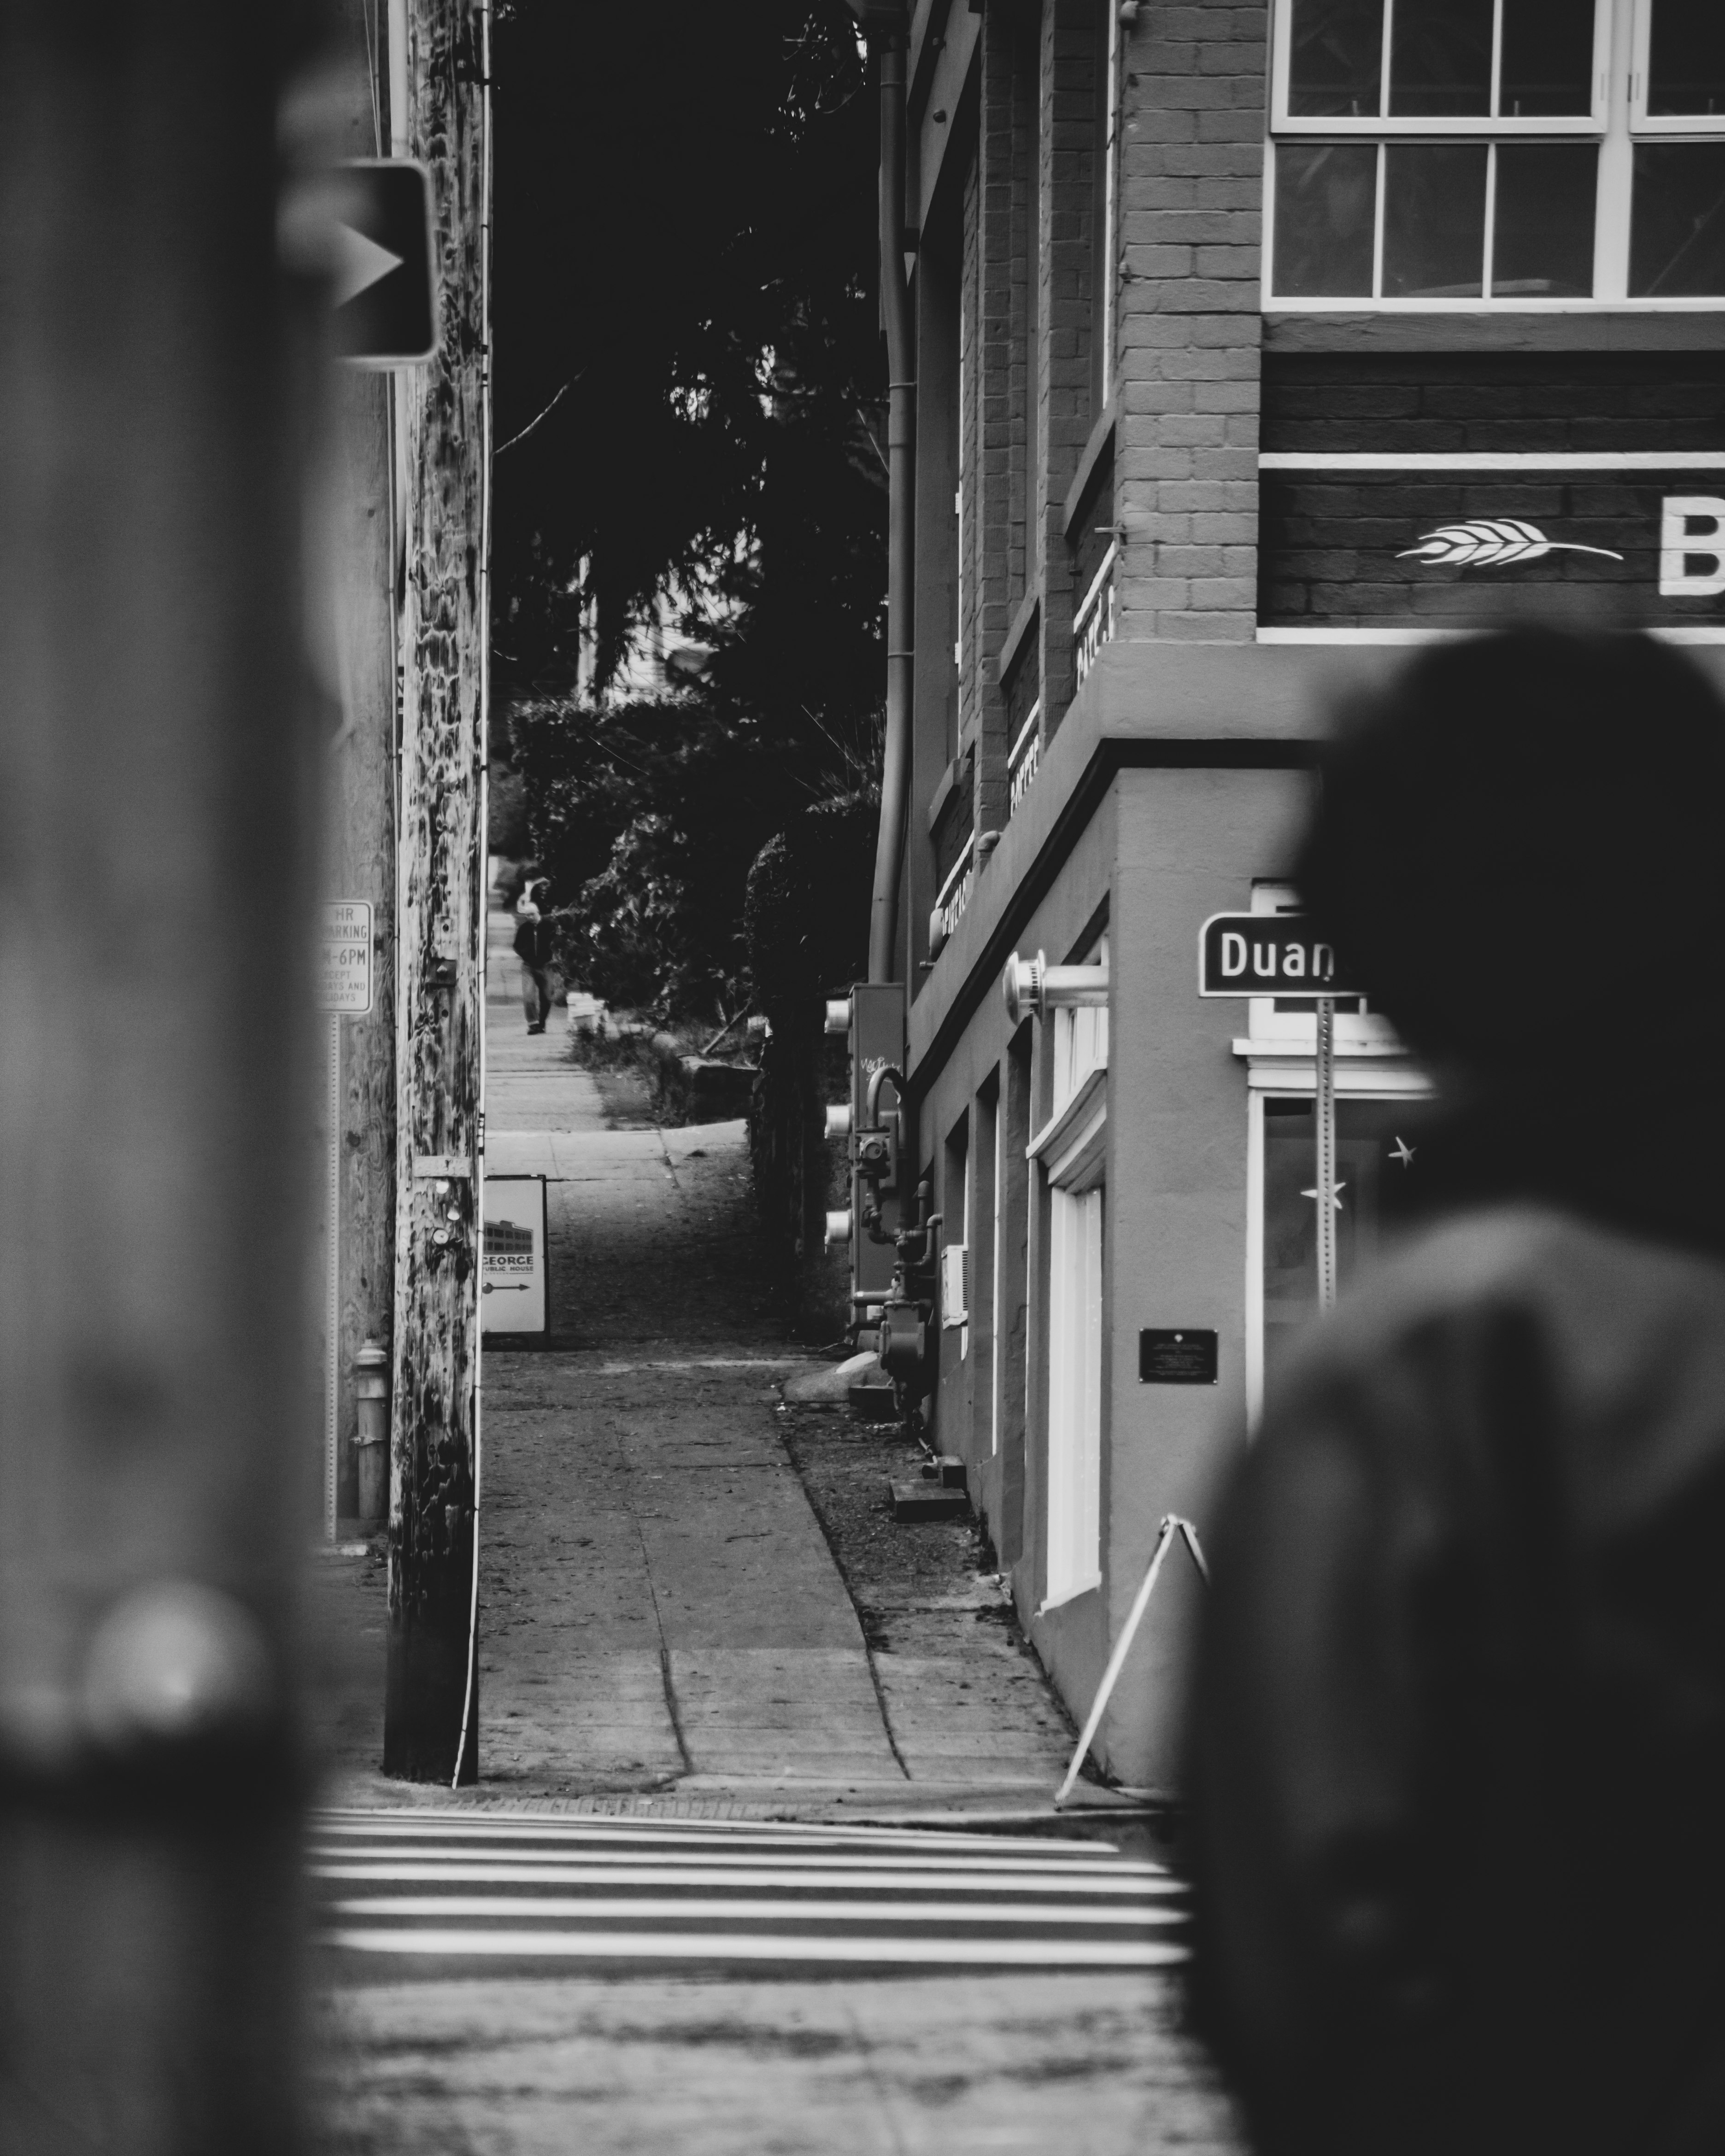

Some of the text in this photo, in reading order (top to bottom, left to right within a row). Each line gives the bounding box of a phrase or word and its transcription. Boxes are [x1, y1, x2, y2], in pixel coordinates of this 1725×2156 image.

[1660, 495, 1725, 596] B
[348, 982, 365, 990] AND
[482, 1256, 534, 1265] GEORGE
